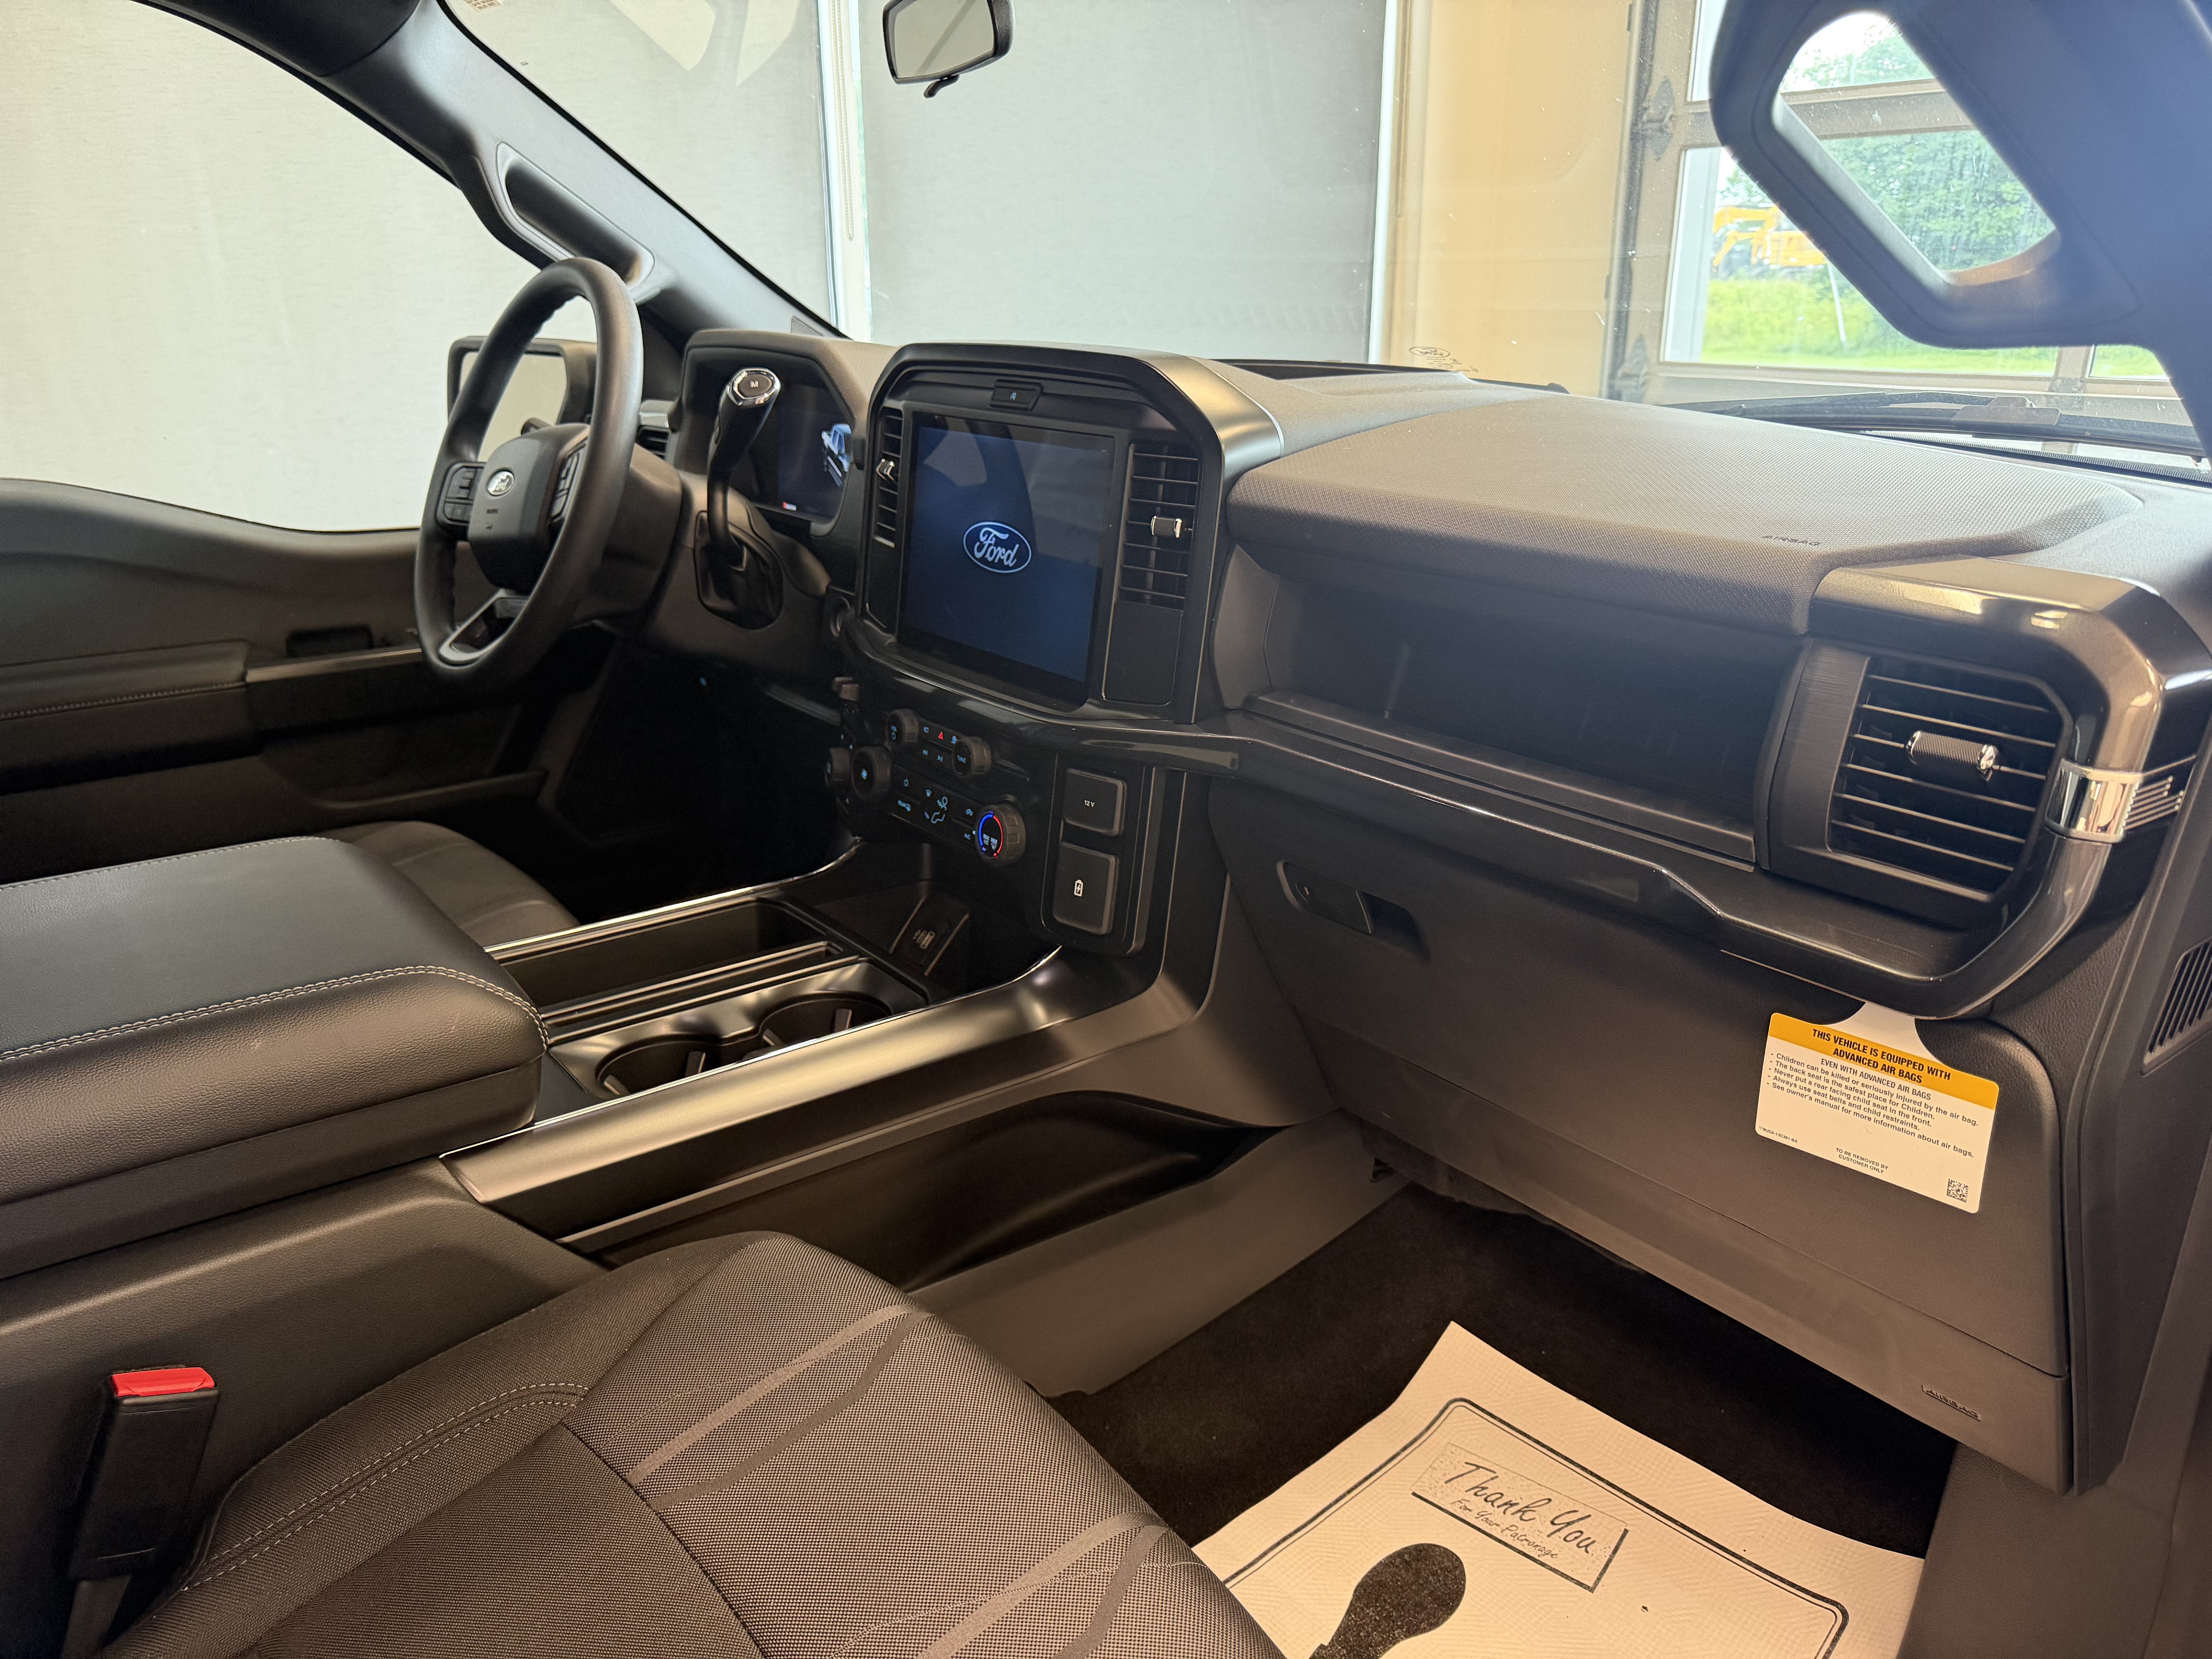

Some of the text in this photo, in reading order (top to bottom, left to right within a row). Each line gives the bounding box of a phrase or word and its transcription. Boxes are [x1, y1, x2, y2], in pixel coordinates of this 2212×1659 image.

[974, 527, 1019, 567] Ford
[1813, 1029, 1951, 1080] THIS VEHICLE IS EQUIPPED WITH
[1821, 1058, 1931, 1100] EVEN WITH ADVANCED AIR BAGS
[1832, 1048, 1922, 1084] ADVANCED AIR BAGS
[1773, 1075, 1797, 1088] Always
[1813, 1090, 1827, 1099] seat
[1829, 1094, 1846, 1105] belts
[1863, 1107, 1881, 1117] child
[1883, 1114, 1919, 1130] restraints.
[1774, 1068, 1794, 1079] Never
[1814, 1082, 1828, 1091] rear
[1830, 1087, 1851, 1100] facing
[1853, 1096, 1870, 1105] child
[1872, 1103, 1887, 1111] seat
[1899, 1110, 1910, 1119] the
[1912, 1115, 1931, 1127] front.
[1776, 1060, 1788, 1069] The
[1790, 1065, 1805, 1075] back
[1808, 1073, 1822, 1081] seat
[1832, 1080, 1842, 1088] the
[1844, 1085, 1865, 1096] safest
[1867, 1093, 1887, 1103] place
[1889, 1099, 1899, 1107] for
[1901, 1103, 1934, 1120] Children.
[1777, 1053, 1805, 1067] Children
[1831, 1071, 1850, 1082] killed
[1861, 1083, 1894, 1098] seriously
[1896, 1093, 1922, 1107] injured
[1924, 1103, 1933, 1111] by
[1936, 1107, 1948, 1115] the
[1962, 1115, 1978, 1126] bag.
[1772, 1082, 1784, 1091] See
[1786, 1089, 1812, 1101] owner's
[1815, 1098, 1840, 1110] manual
[1853, 1111, 1872, 1121] more
[1874, 1117, 1915, 1137] information
[1917, 1134, 1939, 1146] about
[1953, 1145, 1973, 1158] bags.
[1839, 1154, 1868, 1168] CUSTOMER
[1853, 1154, 1879, 1166] REMOVED
[1926, 1389, 1978, 1418] AIRBAG
[1444, 1462, 1596, 1554] Thank You
[1451, 1499, 1558, 1559] For Your Patronage
